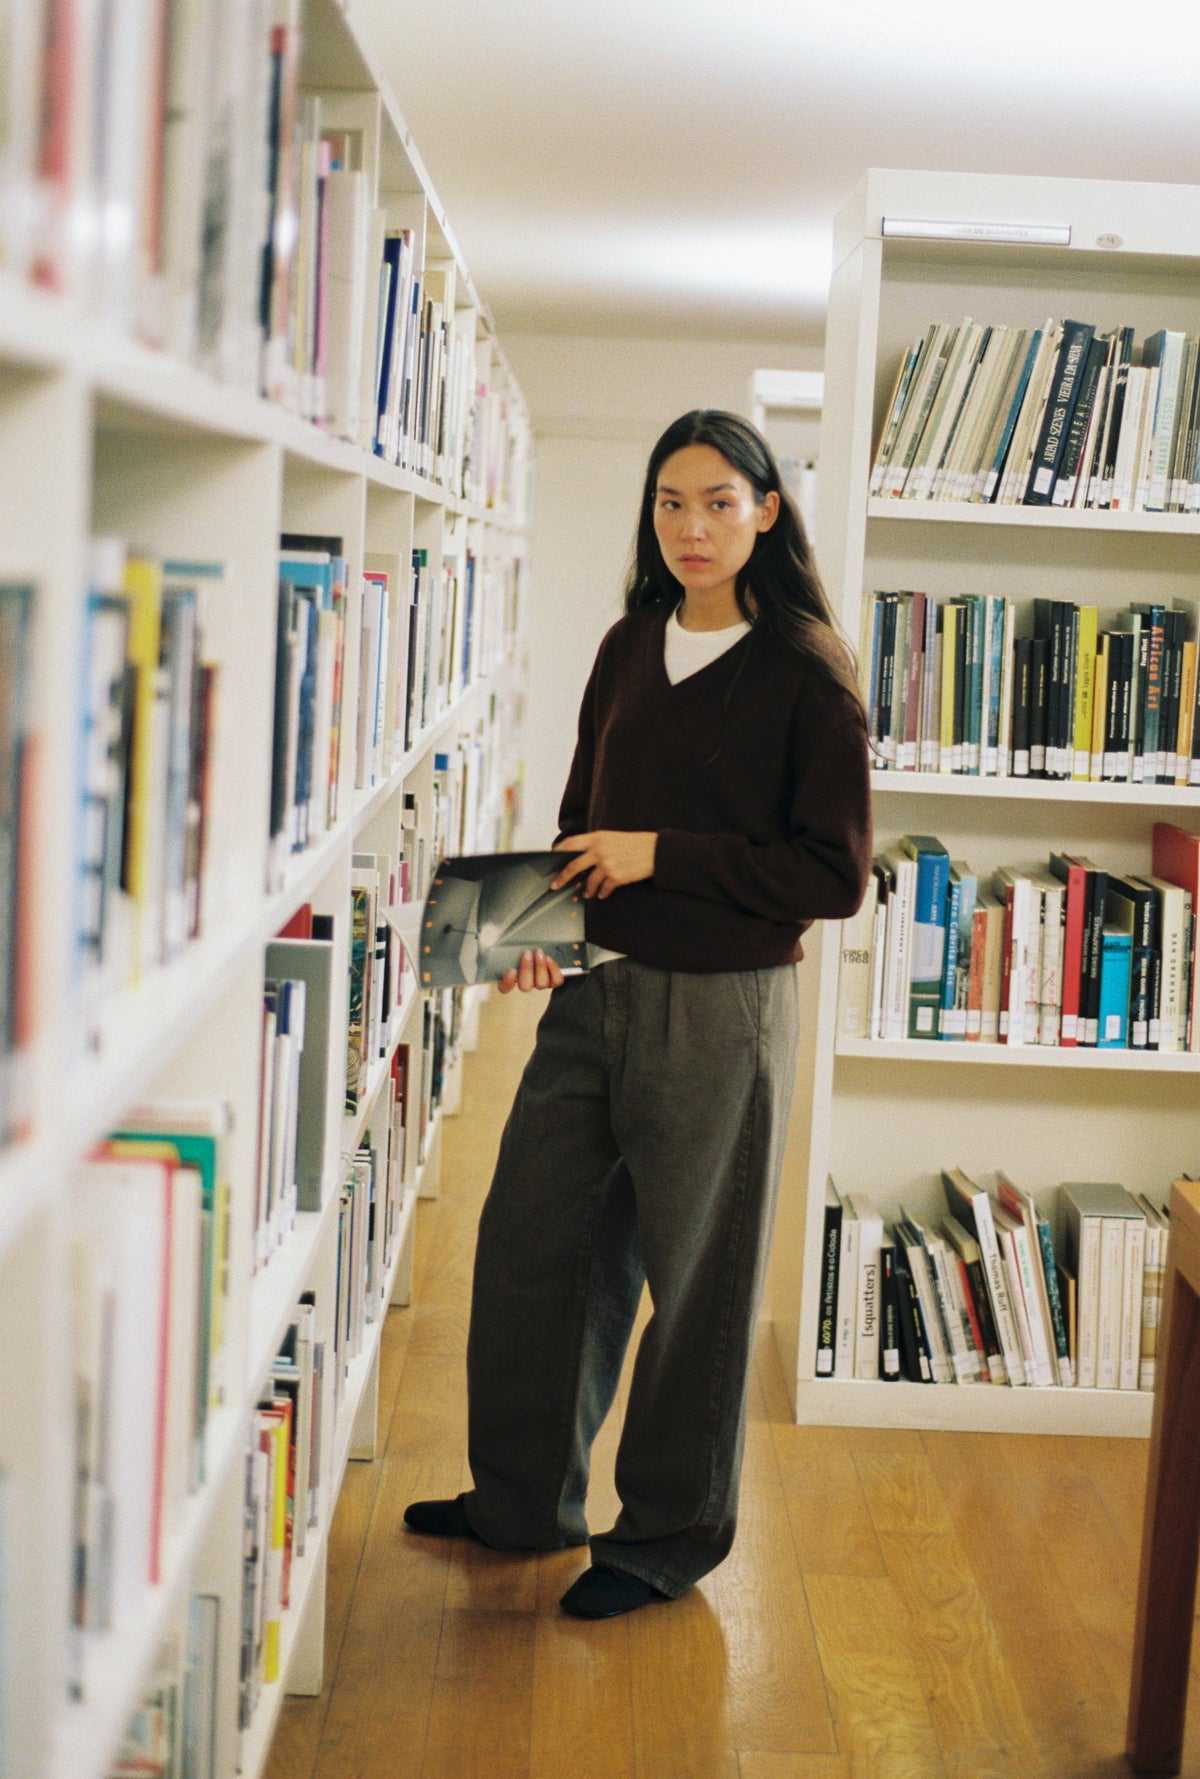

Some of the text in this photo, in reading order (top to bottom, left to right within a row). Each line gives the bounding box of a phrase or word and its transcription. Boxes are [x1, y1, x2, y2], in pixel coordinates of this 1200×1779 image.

[1057, 377, 1074, 403] VIEIRA
[1050, 408, 1068, 436] SZENES
[1070, 402, 1087, 446] AREAL
[1043, 437, 1059, 463] ARPAD
[1147, 625, 1164, 710] African Art
[947, 887, 960, 986] Pedro Cabrita Reis
[1090, 956, 1098, 978] NIKIAS
[1169, 959, 1177, 1003] GRAHAM
[825, 1271, 834, 1303] Artistas
[863, 1264, 876, 1338] [squatters]
[988, 1253, 1003, 1292] Thomas
[997, 1289, 1009, 1313] Ruff
